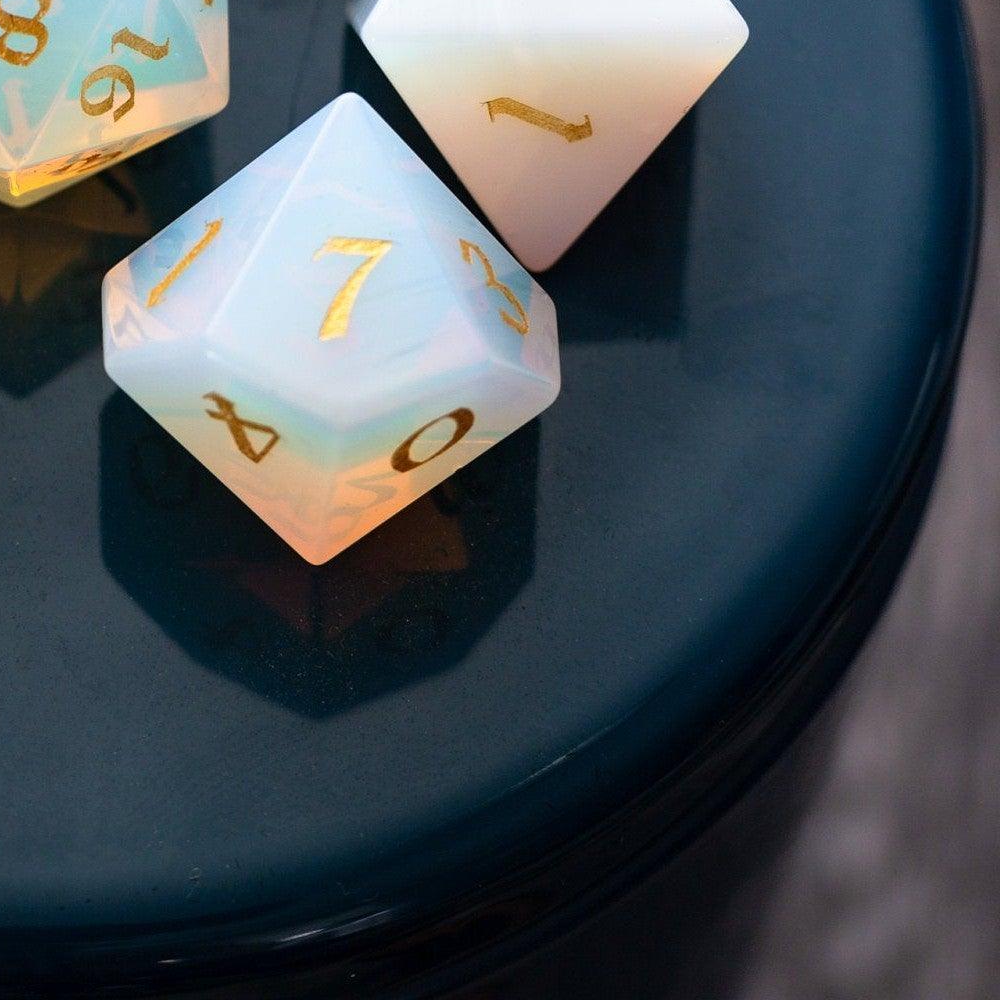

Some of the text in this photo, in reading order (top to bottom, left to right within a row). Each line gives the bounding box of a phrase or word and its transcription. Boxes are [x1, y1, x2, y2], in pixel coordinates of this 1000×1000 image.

[483, 97, 593, 143] 1
[313, 236, 393, 343] 7
[459, 238, 529, 335] 3
[202, 391, 281, 463] 4
[391, 407, 475, 474] 0
